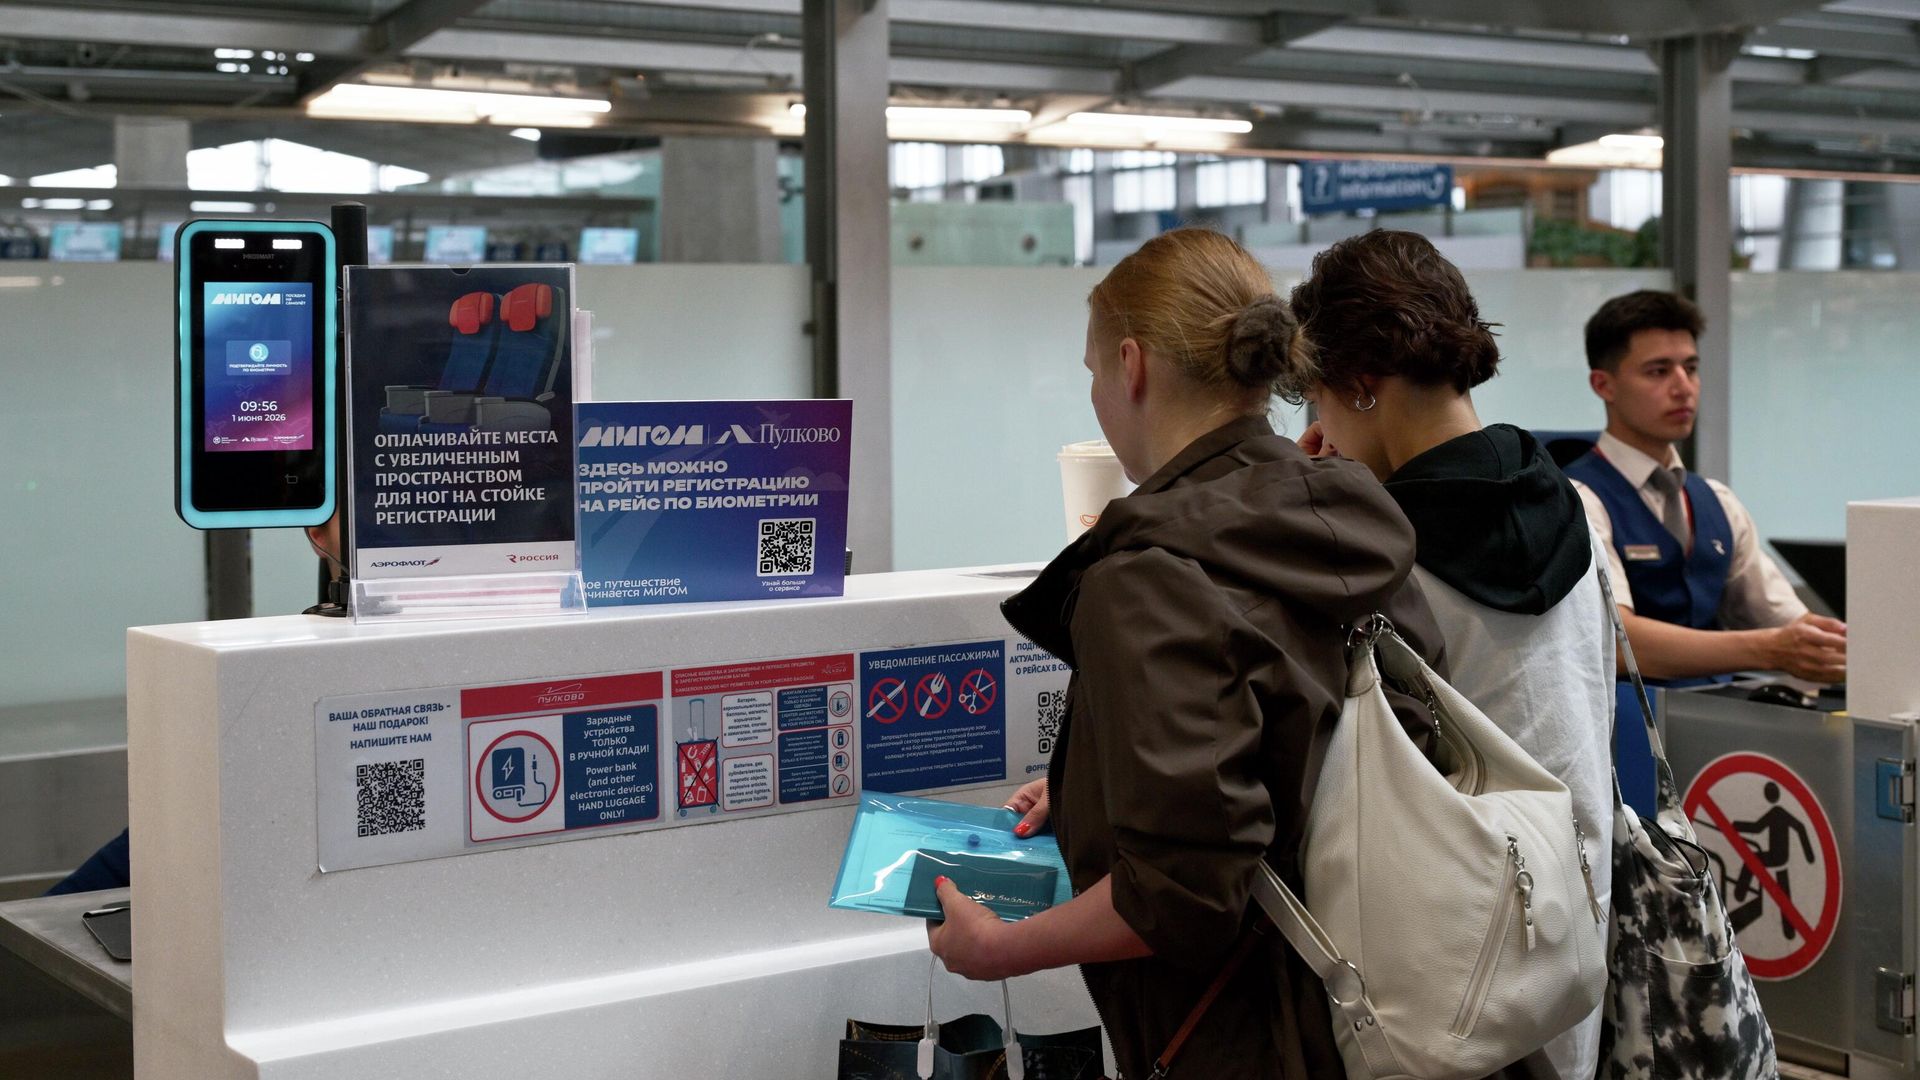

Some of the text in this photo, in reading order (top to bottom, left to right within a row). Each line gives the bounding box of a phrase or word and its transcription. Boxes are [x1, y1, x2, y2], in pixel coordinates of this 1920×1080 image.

[211, 293, 281, 305] МИГОМ
[240, 401, 278, 411] 09:56
[374, 430, 558, 448] ОПЛАЧИВАЙТЕ МЕСТА
[579, 424, 840, 449] МИГОМ Пулково
[375, 450, 520, 467] С УВЕЛИЧЕННЫМ
[579, 460, 728, 478] ЗДЕСЬ МОЖНО
[375, 469, 522, 486] ПРОСТРАНСТВОМ
[580, 476, 810, 494] ПРОЙТИ РЕГИСТРАЦИЮ
[375, 485, 546, 508] ДЛЯ НОГ НА СТОЙКЕ
[580, 493, 818, 512] НА РЕЙС ПО БИОМЕТРИИ
[376, 508, 496, 525] РЕГИСТРАЦИИ
[604, 578, 680, 590] путешествие
[643, 586, 688, 596] МИГОМ
[868, 649, 1000, 670] УВЕДОМЛЕНИЕ ПАССАЖИРАМ
[1023, 665, 1050, 674] РЕЙСАХ
[329, 703, 444, 721] ВАША ОБРАТНАЯ СВЯЗЬ
[353, 717, 429, 732] НАШ ПОДАРОК!
[587, 714, 632, 726] Зарядные
[584, 725, 635, 739] устройства
[350, 733, 432, 749] НАПИШИТЕ НАМ
[592, 736, 627, 747] ТОЛЬКО
[577, 747, 614, 760] РУЧНОЙ
[616, 745, 650, 757] КЛАДИ!
[586, 762, 636, 776] Power bank
[588, 774, 635, 788] (and other
[570, 784, 653, 800] electronic devices)
[578, 796, 646, 811] HAND LUGGAGE
[600, 810, 624, 820] ONLY!
